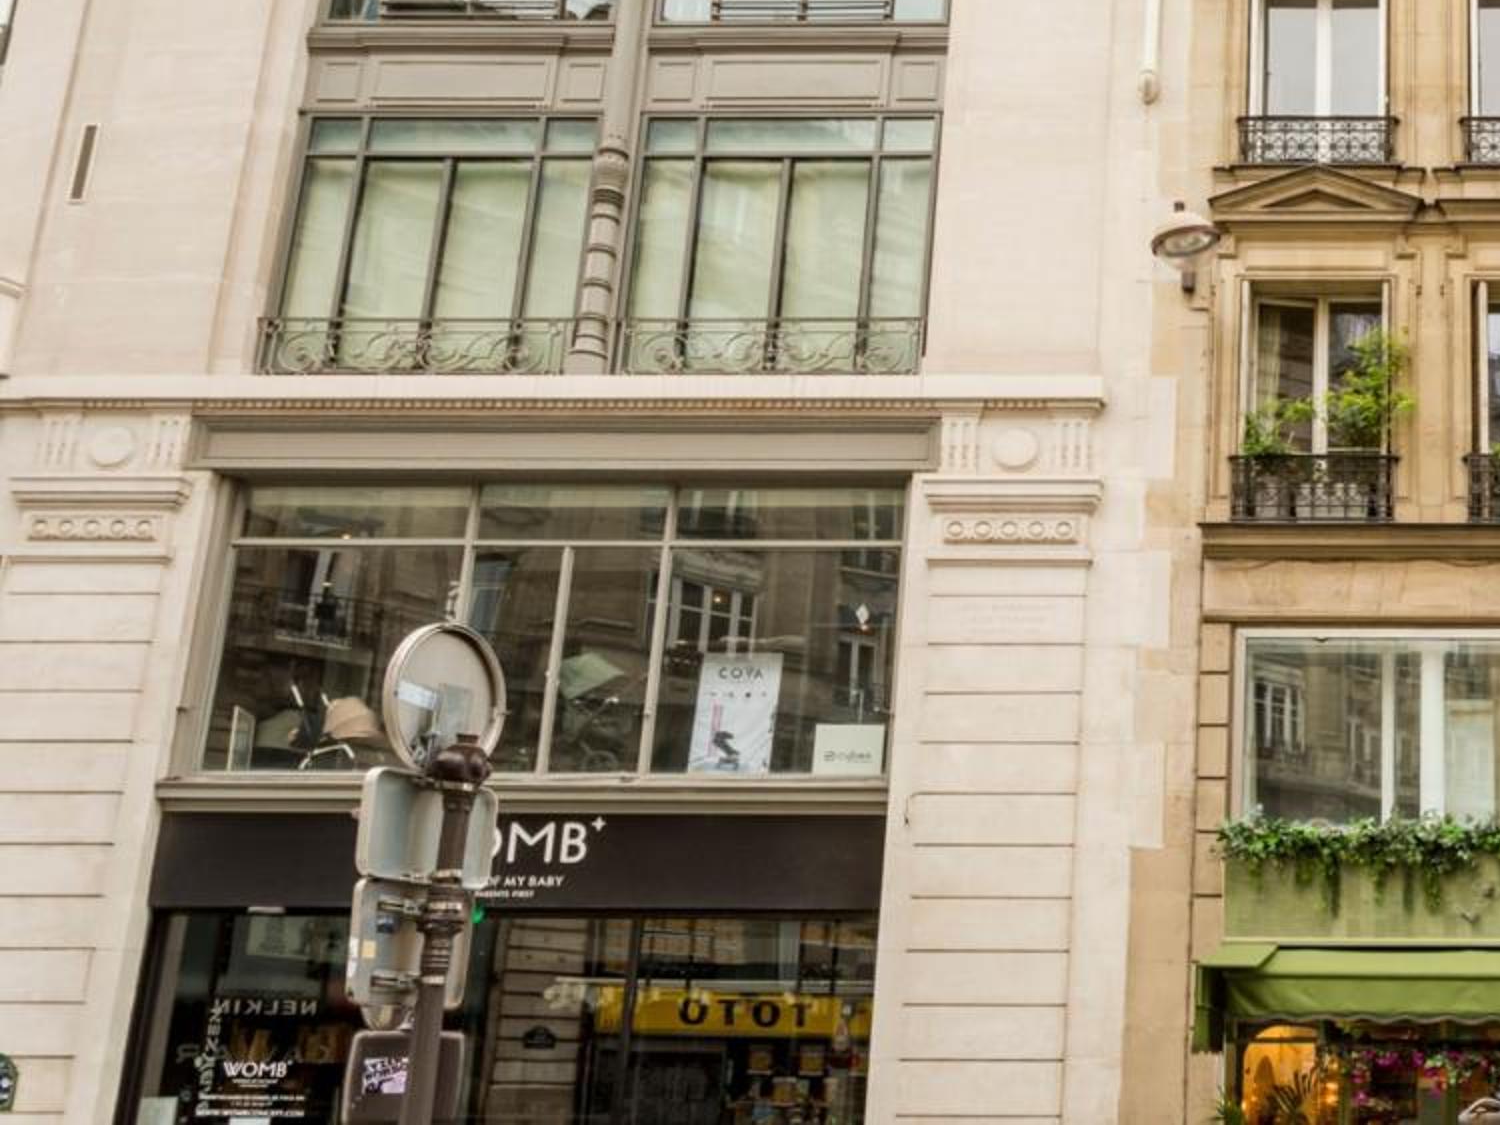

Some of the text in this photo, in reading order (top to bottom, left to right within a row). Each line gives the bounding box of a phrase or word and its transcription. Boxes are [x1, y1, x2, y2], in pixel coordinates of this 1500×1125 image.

[493, 821, 588, 864] MB
[528, 876, 564, 886] BABY
[224, 1061, 288, 1078] WOMB
